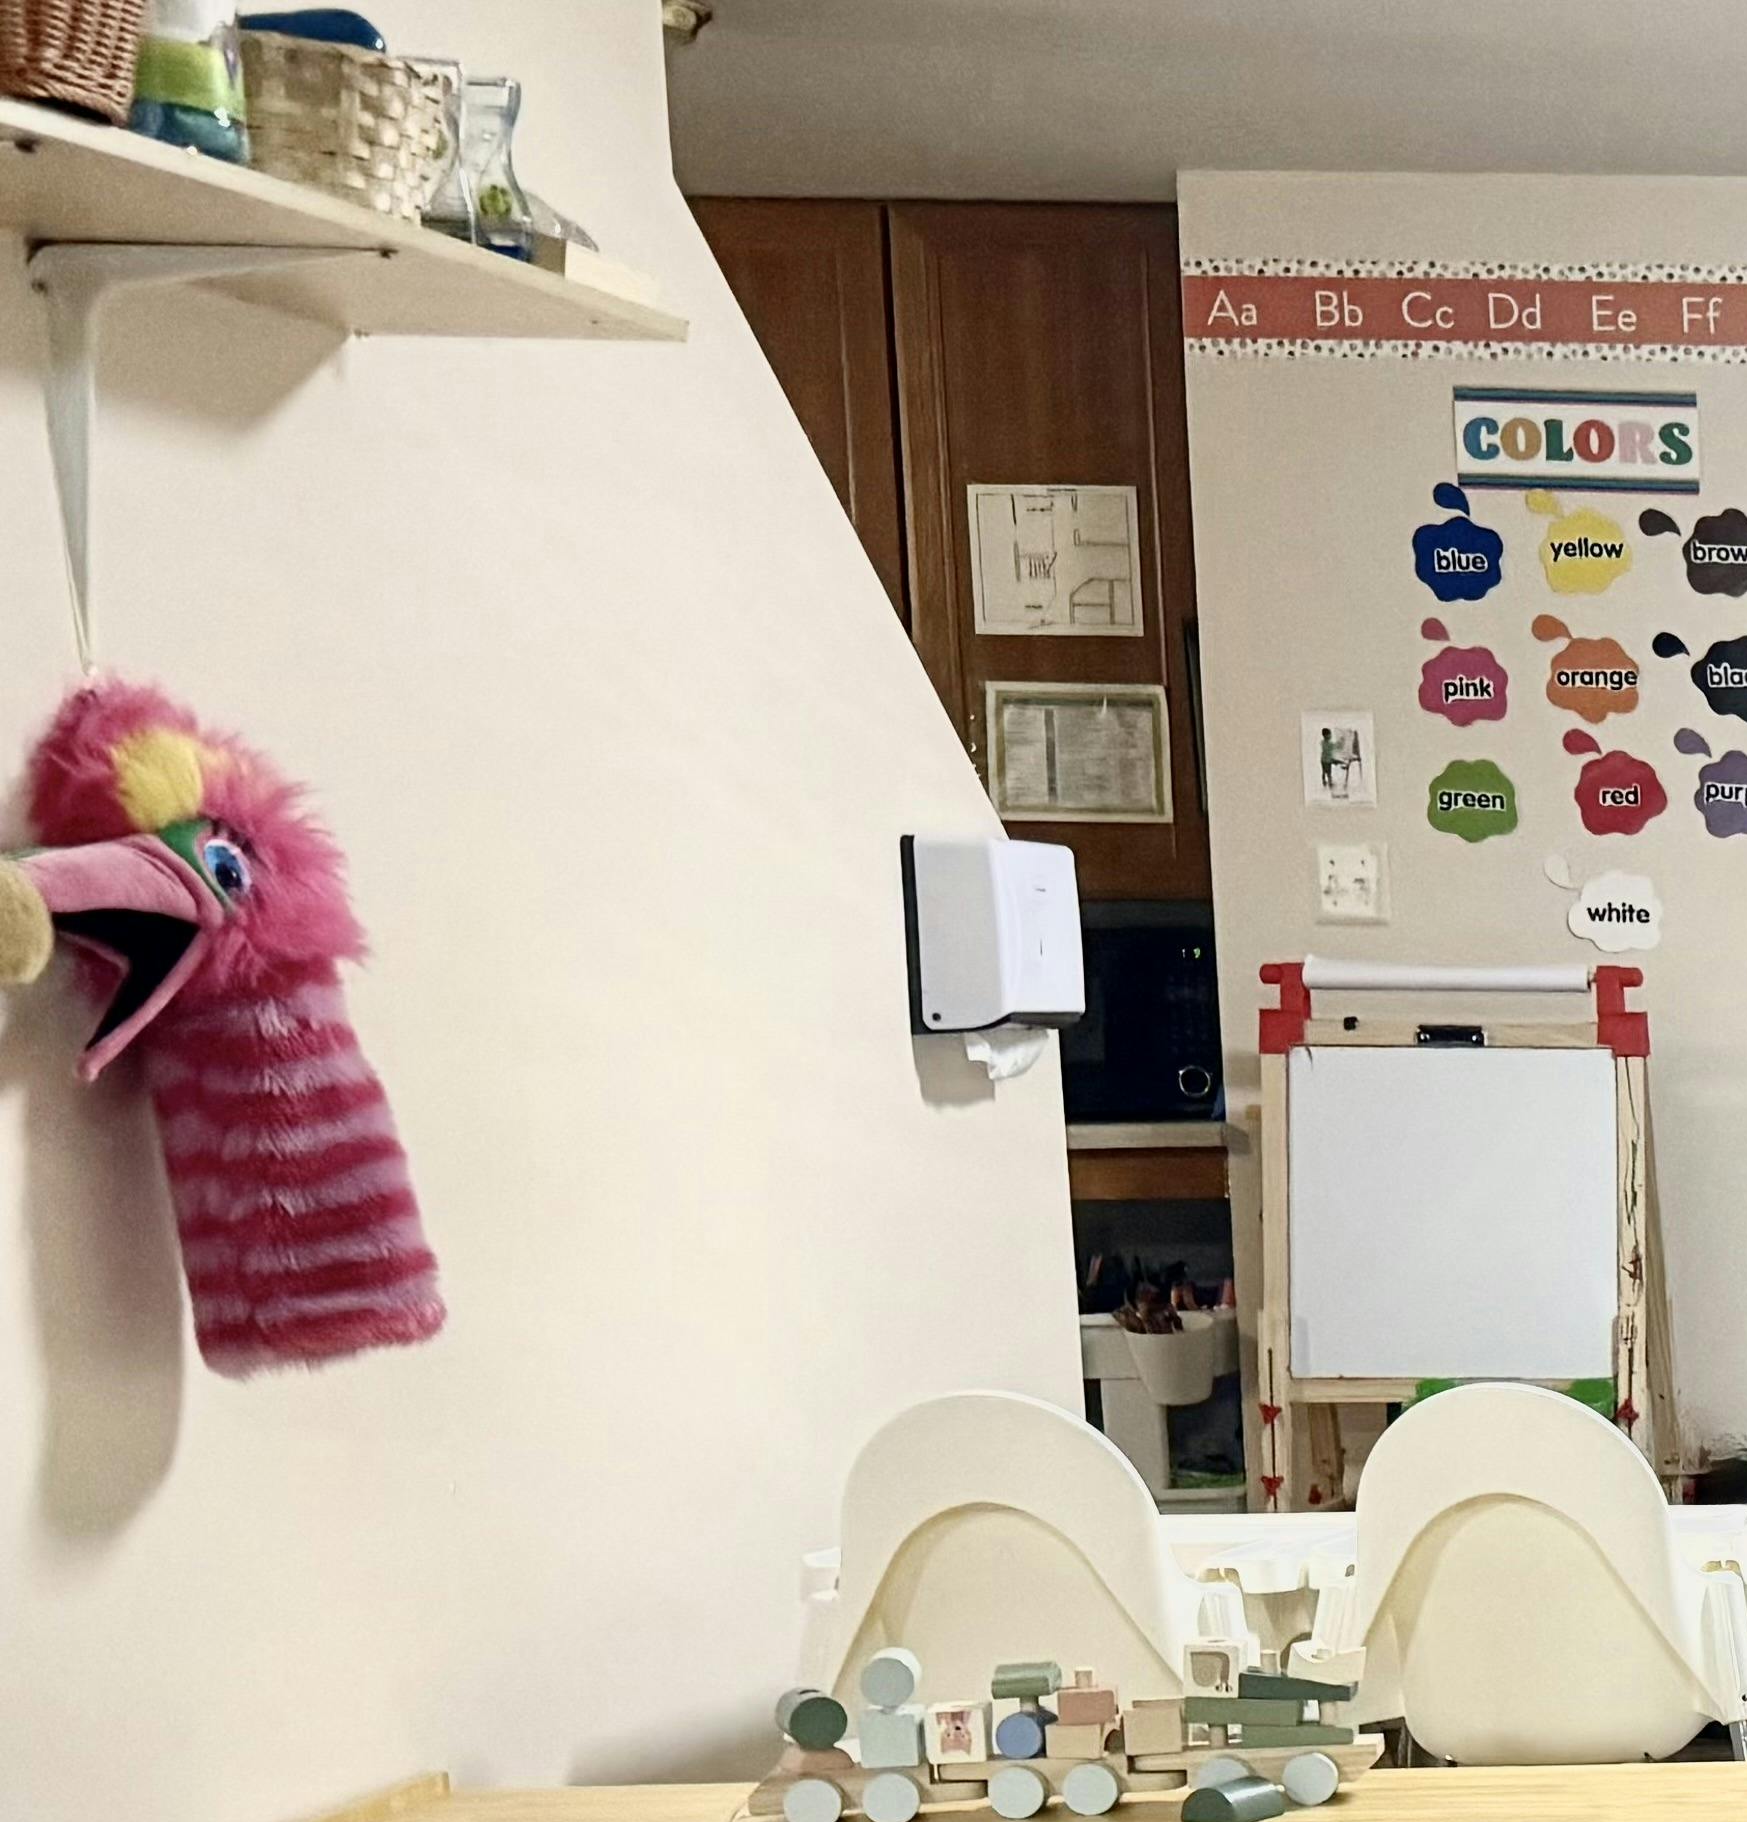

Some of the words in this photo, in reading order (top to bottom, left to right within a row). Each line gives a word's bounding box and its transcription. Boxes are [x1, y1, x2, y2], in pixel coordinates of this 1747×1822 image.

[1208, 292, 1257, 327] Aa
[1315, 293, 1363, 329] Bb
[1402, 293, 1454, 330] Cc
[1490, 294, 1542, 330] Dd
[1594, 296, 1637, 332] Ee
[1684, 297, 1723, 335] Ff
[1463, 416, 1694, 466] COLORS
[1435, 550, 1487, 573] blue
[1550, 538, 1624, 562] yellow
[1444, 677, 1493, 700] pink
[1557, 669, 1638, 692] orange
[1439, 790, 1505, 811] green
[1601, 785, 1639, 806] red
[1587, 904, 1650, 924] white
